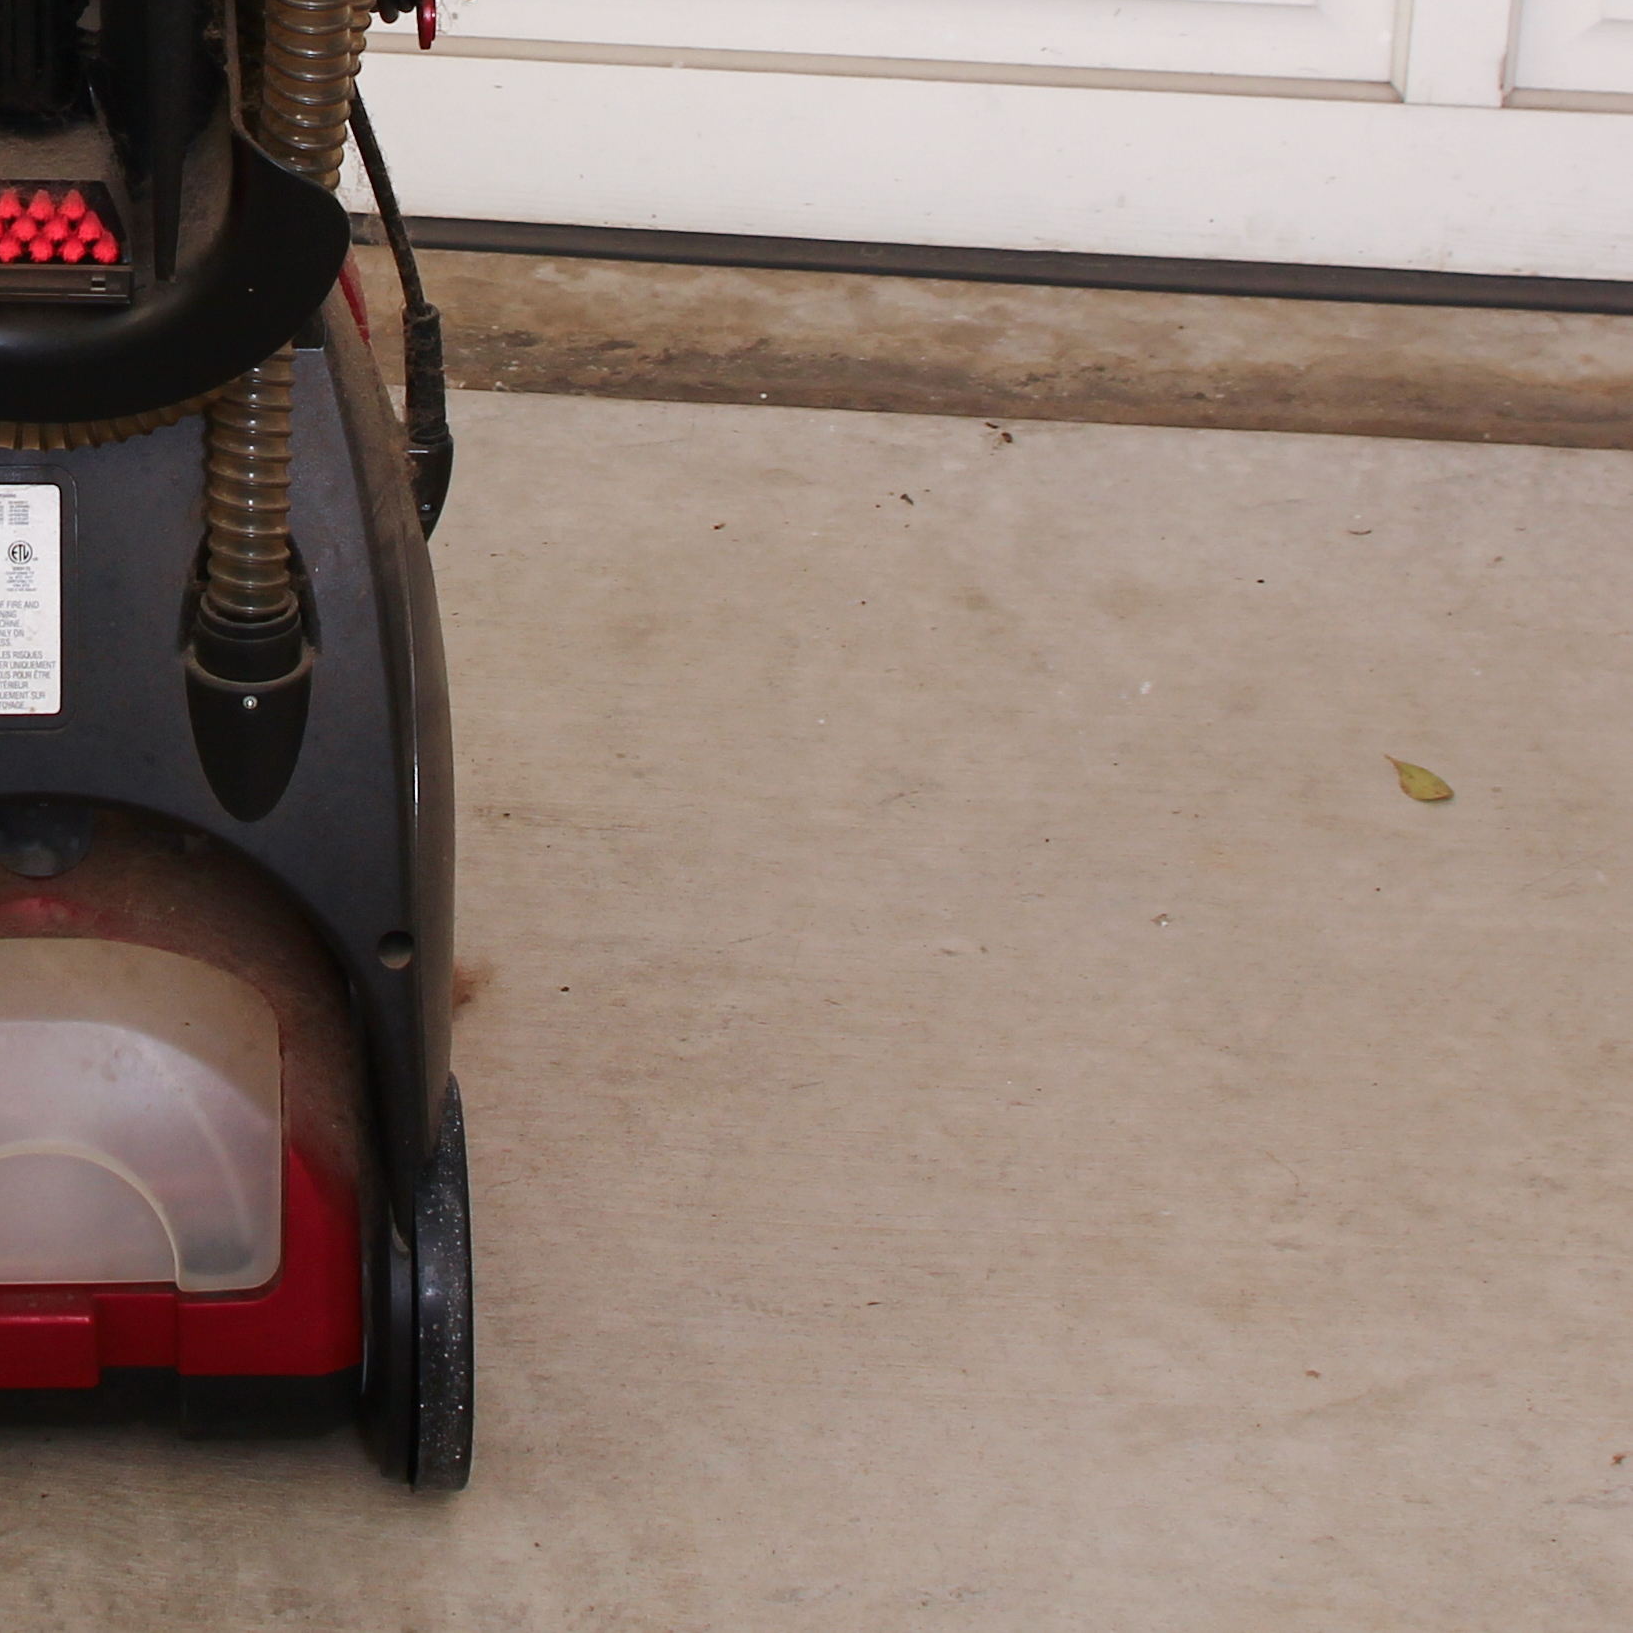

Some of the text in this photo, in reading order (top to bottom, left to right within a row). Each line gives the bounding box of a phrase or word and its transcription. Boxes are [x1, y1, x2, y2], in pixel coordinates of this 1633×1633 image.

[7, 600, 22, 609] FIRE
[24, 600, 40, 609] AND
[13, 650, 43, 659] RISQUES
